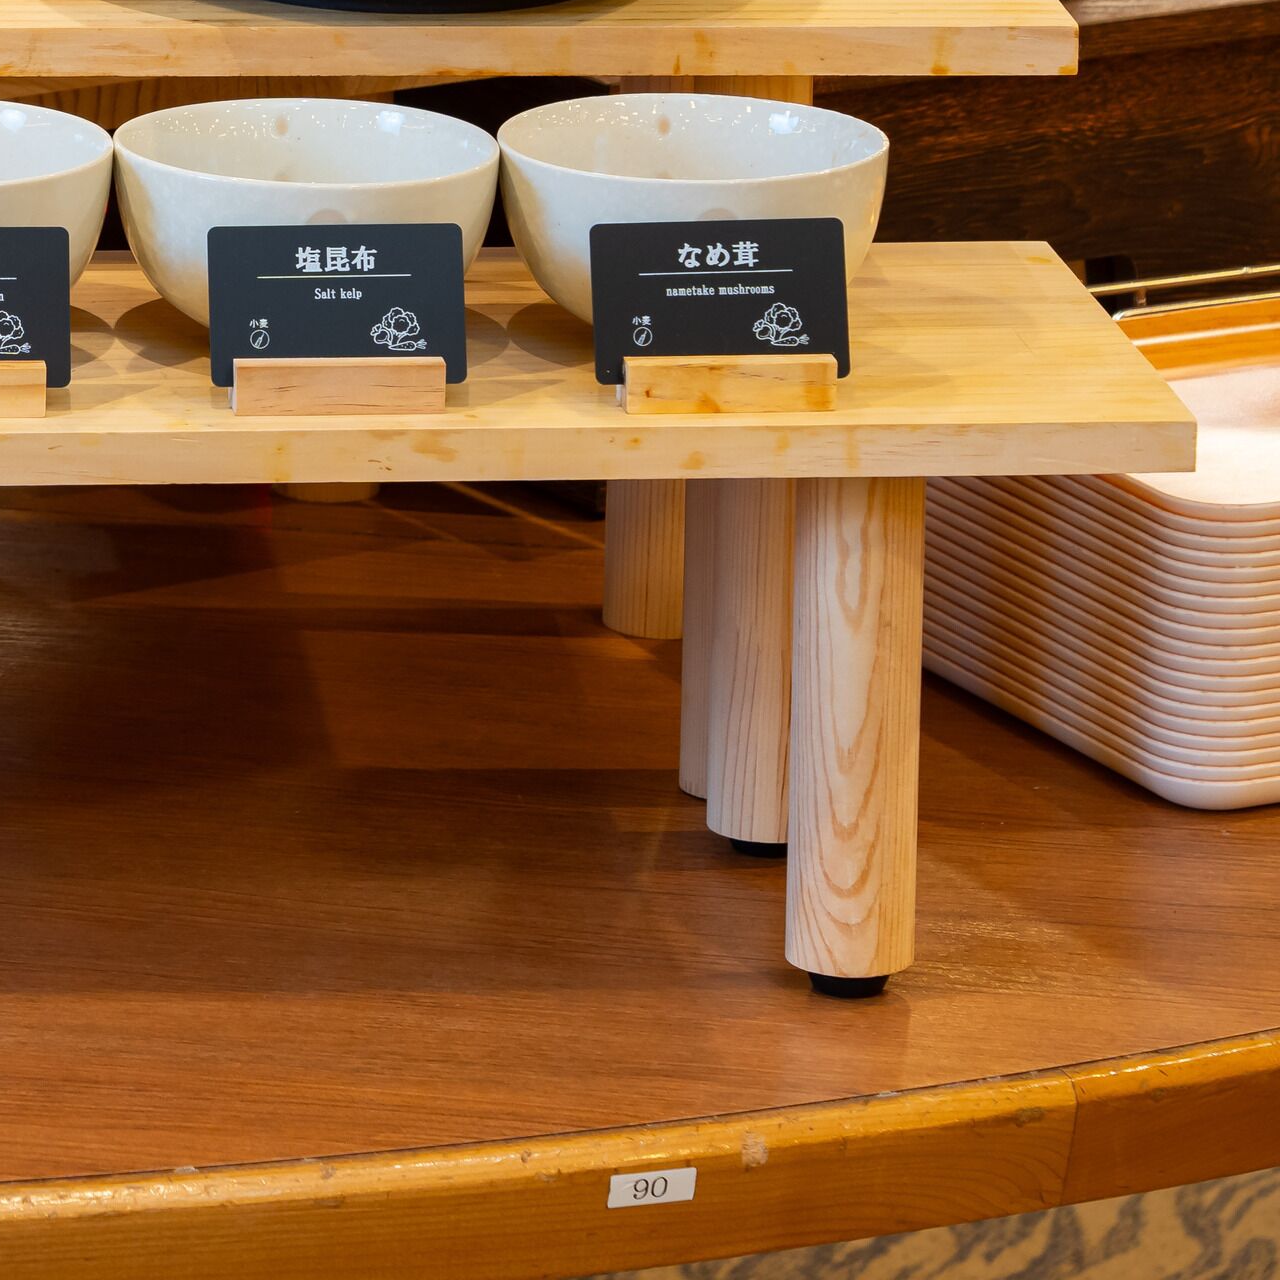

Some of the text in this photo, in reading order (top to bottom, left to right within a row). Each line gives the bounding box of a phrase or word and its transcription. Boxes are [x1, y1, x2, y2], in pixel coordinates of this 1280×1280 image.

[295, 245, 378, 273] 塩昆布
[677, 240, 760, 269] なめ茸
[314, 287, 363, 300] Salt kelp
[665, 283, 775, 297] nametake mushrooms
[249, 318, 269, 329] 小麦
[632, 315, 652, 326] 小麦
[632, 1176, 668, 1200] 90
